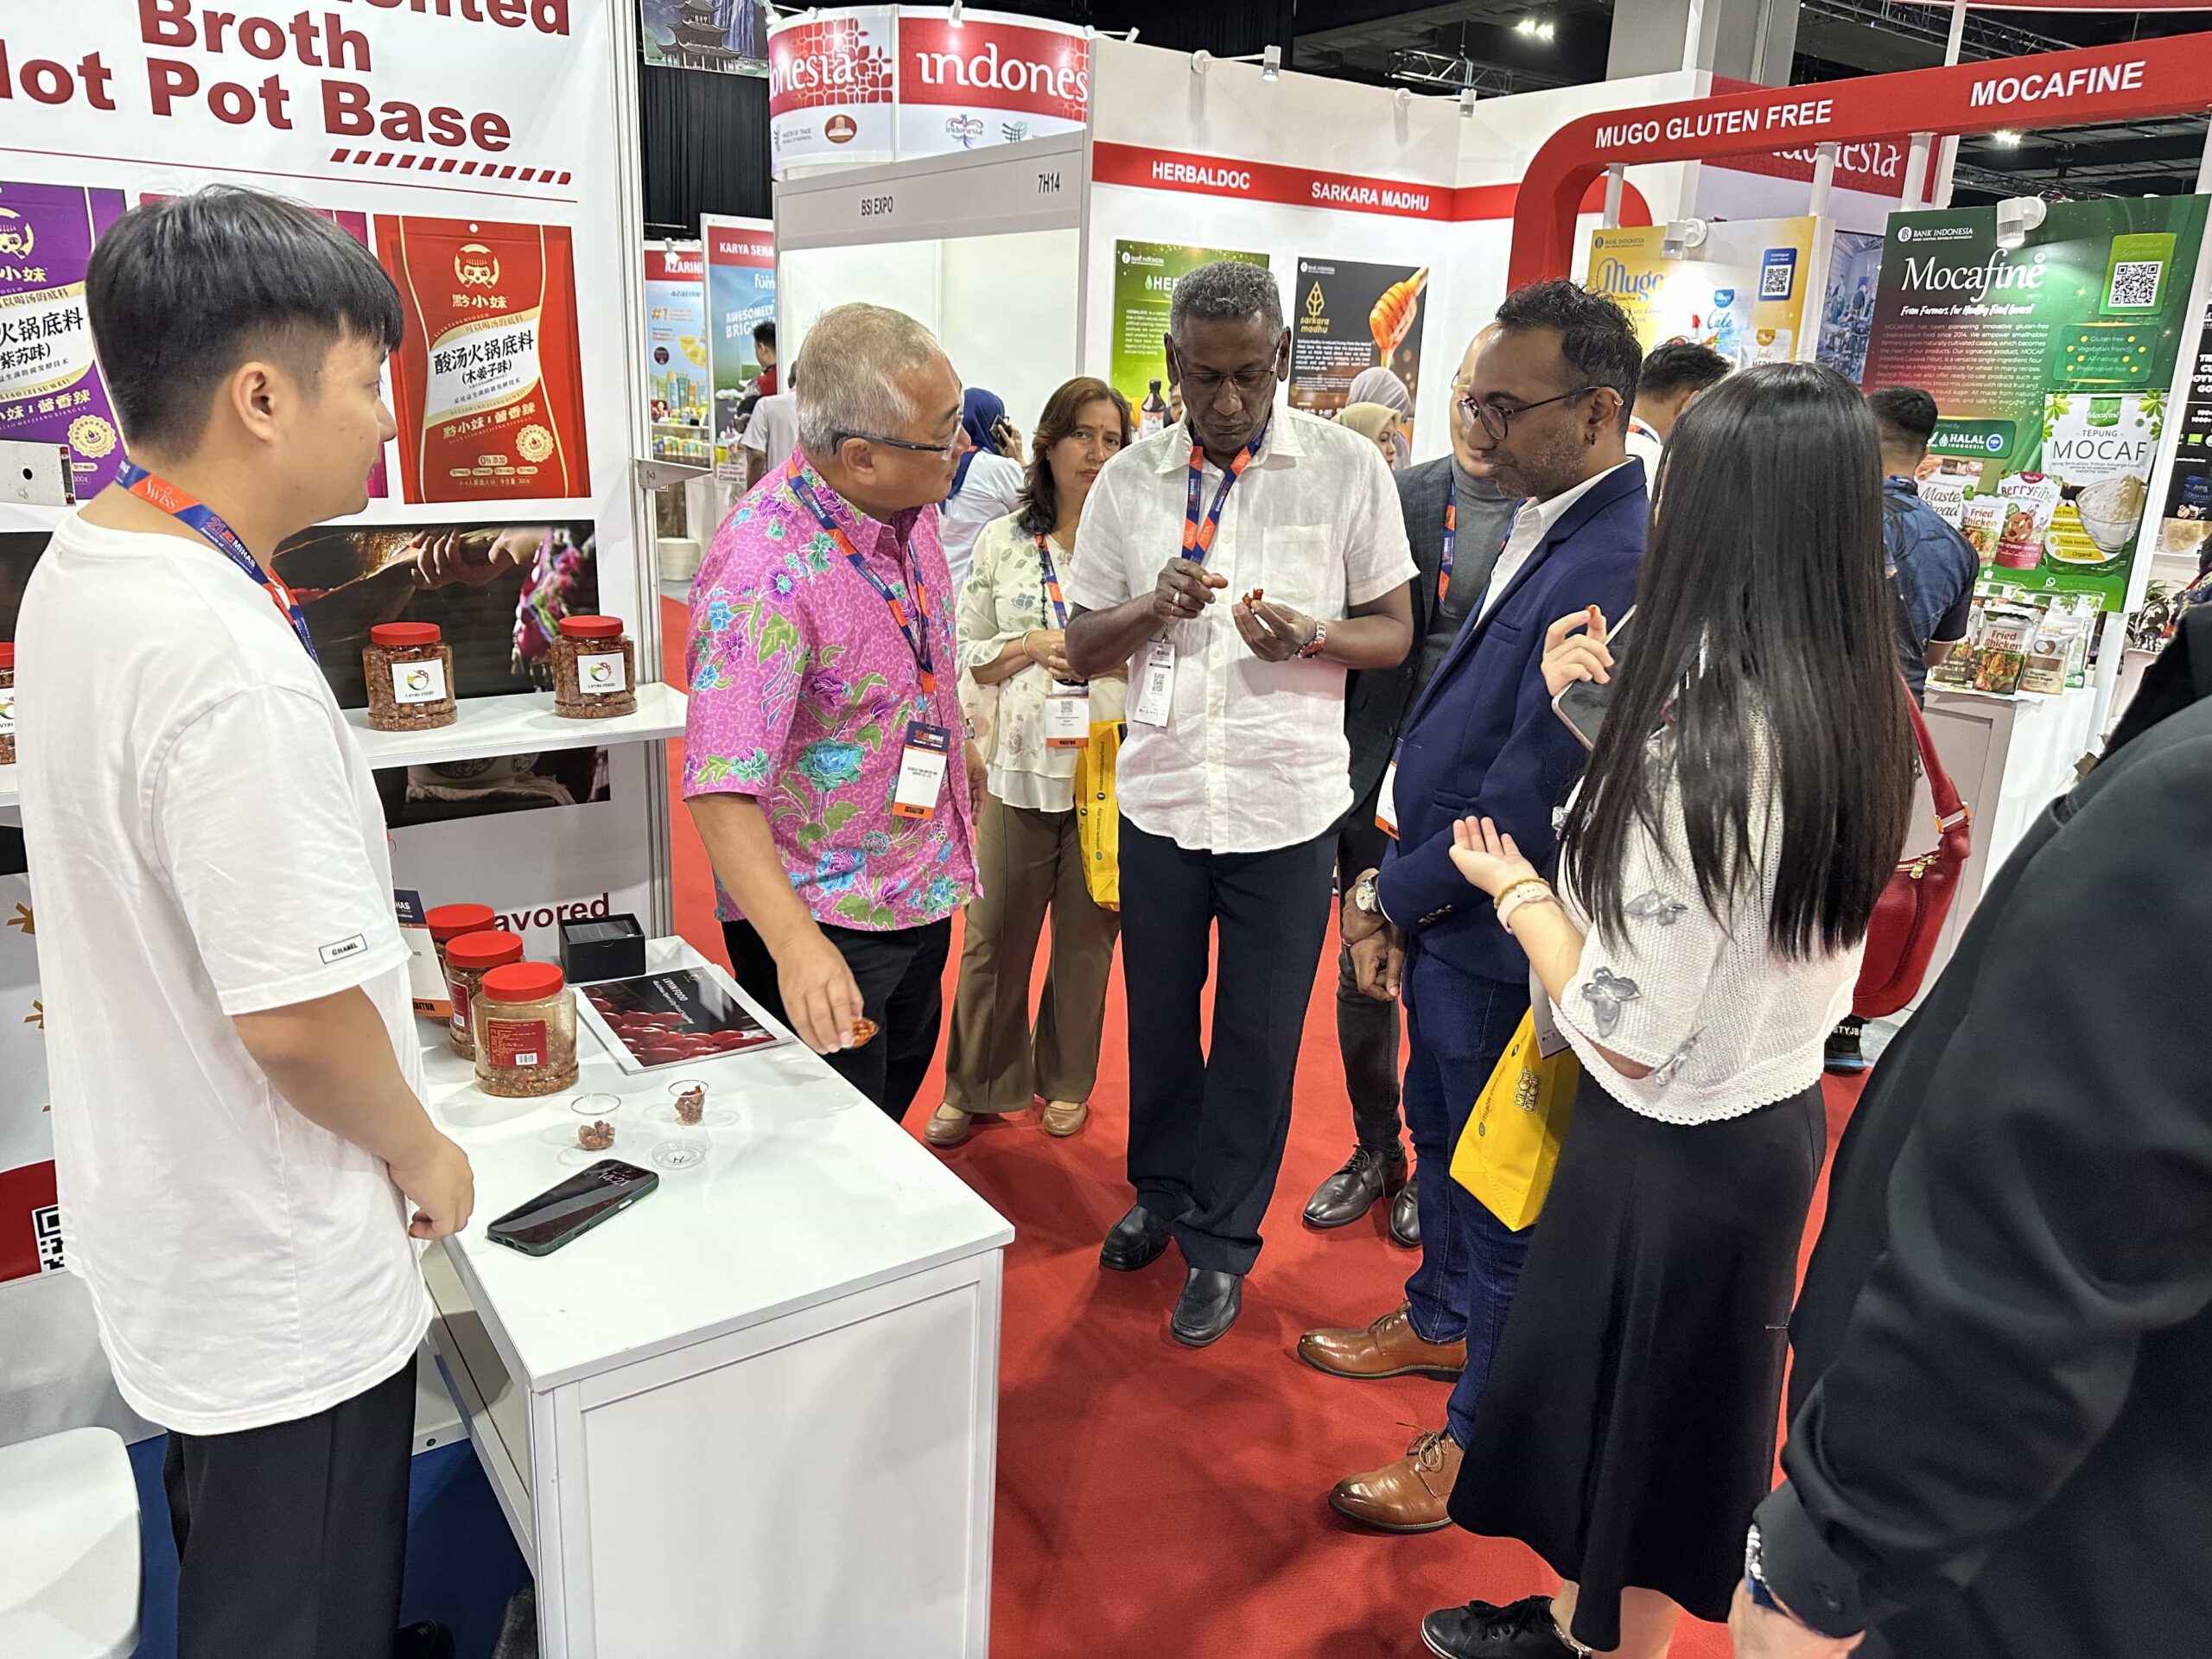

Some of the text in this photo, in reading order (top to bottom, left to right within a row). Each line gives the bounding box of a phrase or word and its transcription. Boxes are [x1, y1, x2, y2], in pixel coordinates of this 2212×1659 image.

[138, 0, 372, 72] Broth
[769, 51, 855, 98] onesia
[916, 42, 1088, 103] indones
[1970, 61, 2145, 107] MOCAFINE
[146, 57, 293, 130] Pot
[321, 79, 512, 152] Base
[1595, 99, 1833, 149] MUGO GLUTEN FREE
[1038, 172, 1060, 194] 7H14
[1152, 162, 1250, 190] HERBALDOC
[1312, 181, 1429, 212] SARKARA MADHU
[861, 197, 893, 216] BSI EXPO
[1913, 227, 1974, 238] BANK INDONESIA
[719, 242, 749, 255] KARYA
[0, 266, 48, 283] 小妹
[1901, 248, 2046, 302] Mocafine
[451, 294, 508, 309] 黔小妹
[1900, 305, 1919, 316] From
[1949, 304, 1961, 316] for
[652, 308, 668, 321] #1
[1300, 316, 1330, 326] sarkara
[0, 307, 84, 346] 火锅底料
[1300, 325, 1328, 334] madhu
[434, 329, 535, 375] 酸汤火锅底料
[1949, 433, 1985, 445] HALAL
[2052, 440, 2147, 461] MOCAF
[1921, 486, 1961, 502] Maste
[811, 499, 826, 518] MIHAS
[1970, 508, 1994, 518] Fried
[1962, 518, 1997, 528] Chicken
[232, 539, 256, 568] MIHAS
[872, 573, 887, 591] MIHAS
[1992, 630, 2018, 640] Fried
[1984, 639, 2022, 651] Chicken
[395, 901, 410, 911] HAS
[494, 893, 610, 933] avored
[332, 943, 358, 956] CHANEL
